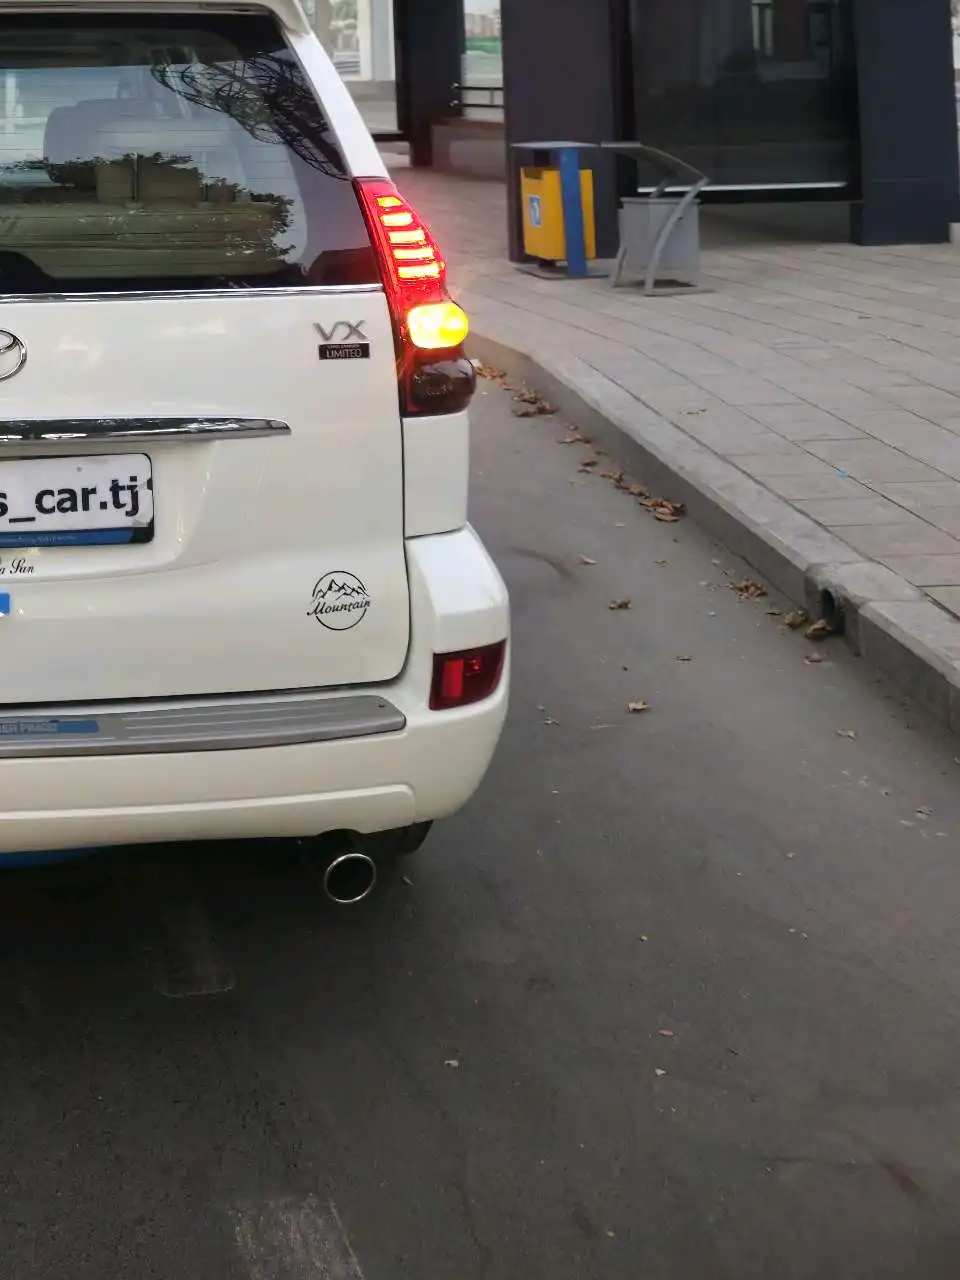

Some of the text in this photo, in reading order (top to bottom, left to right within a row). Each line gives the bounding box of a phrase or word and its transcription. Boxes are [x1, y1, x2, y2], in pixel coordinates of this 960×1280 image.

[312, 319, 367, 341] VX
[326, 349, 362, 359] LIMITED
[9, 557, 35, 574] Sun
[306, 600, 370, 616] Mountain
